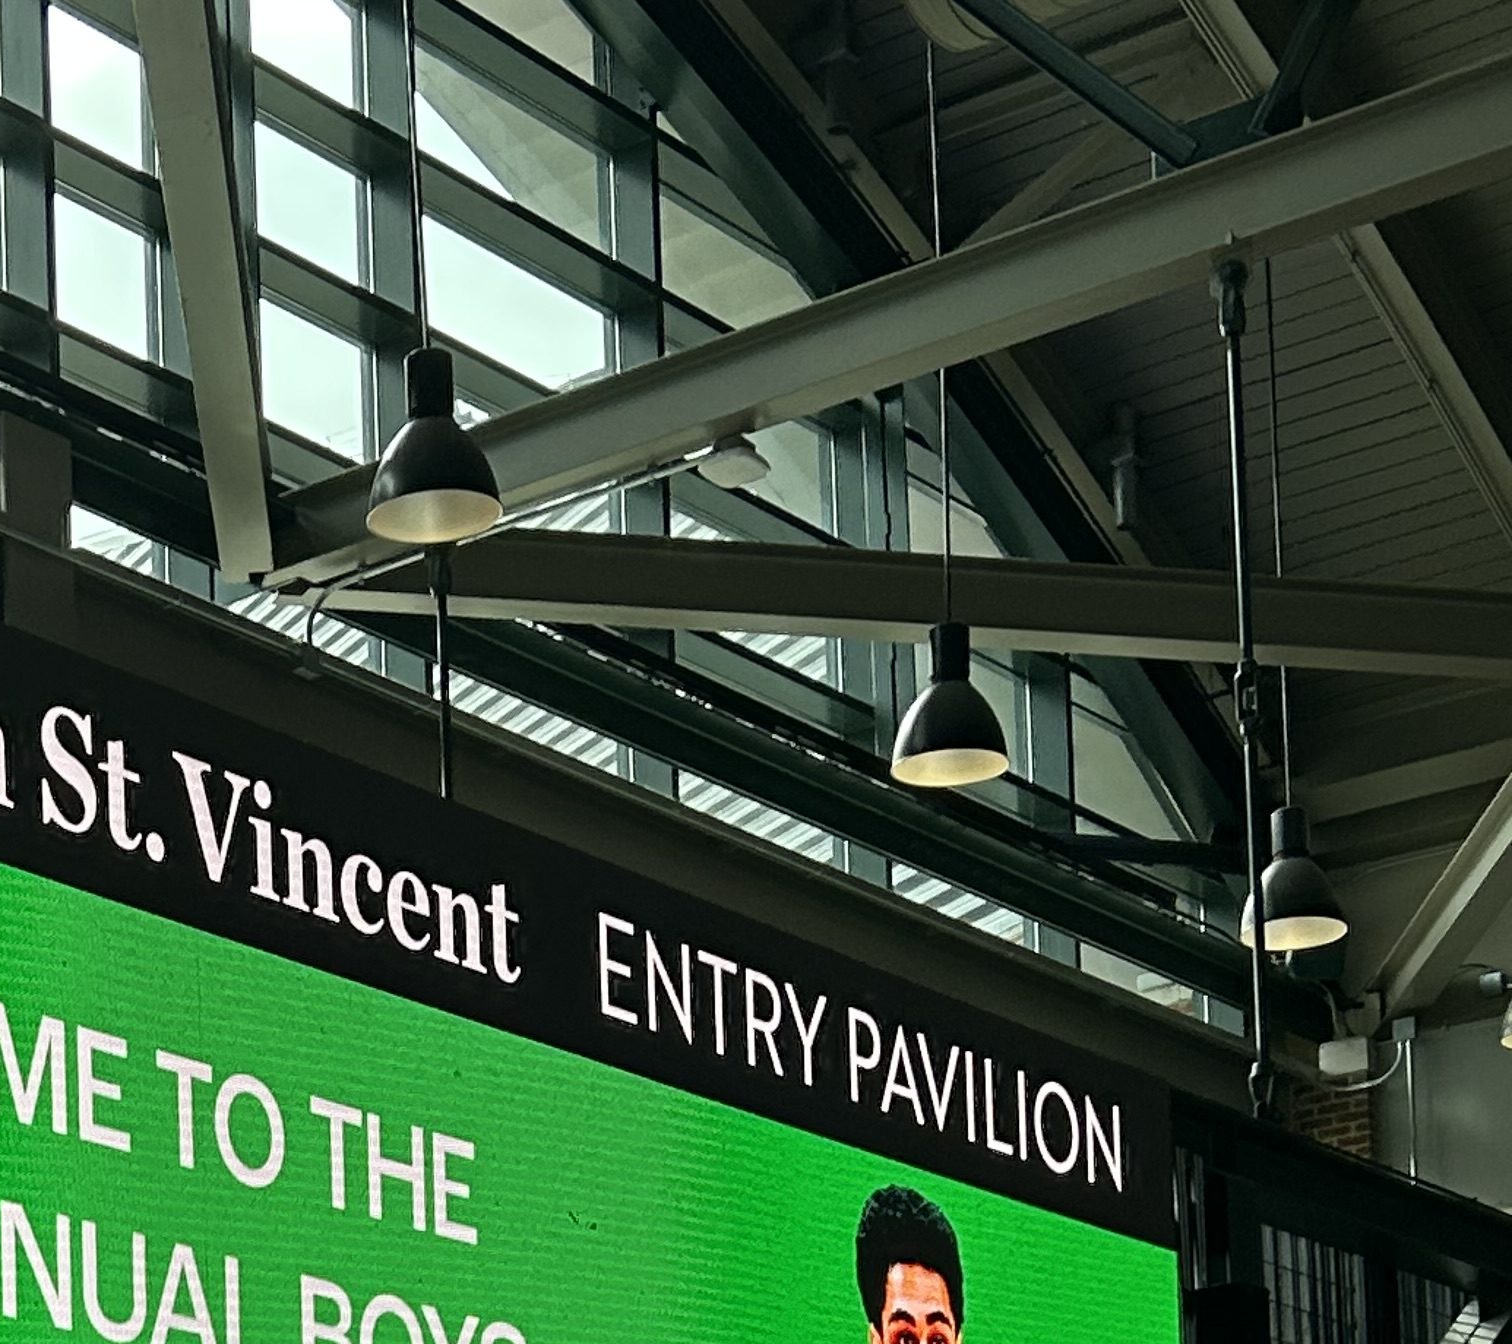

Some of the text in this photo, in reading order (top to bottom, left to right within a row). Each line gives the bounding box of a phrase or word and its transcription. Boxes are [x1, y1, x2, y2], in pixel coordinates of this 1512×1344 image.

[40, 706, 165, 863] St.
[172, 750, 522, 984] Vincent
[155, 1048, 285, 1188] TO
[309, 1094, 478, 1245] THE
[598, 911, 1123, 1194] ENTRY PAVILION
